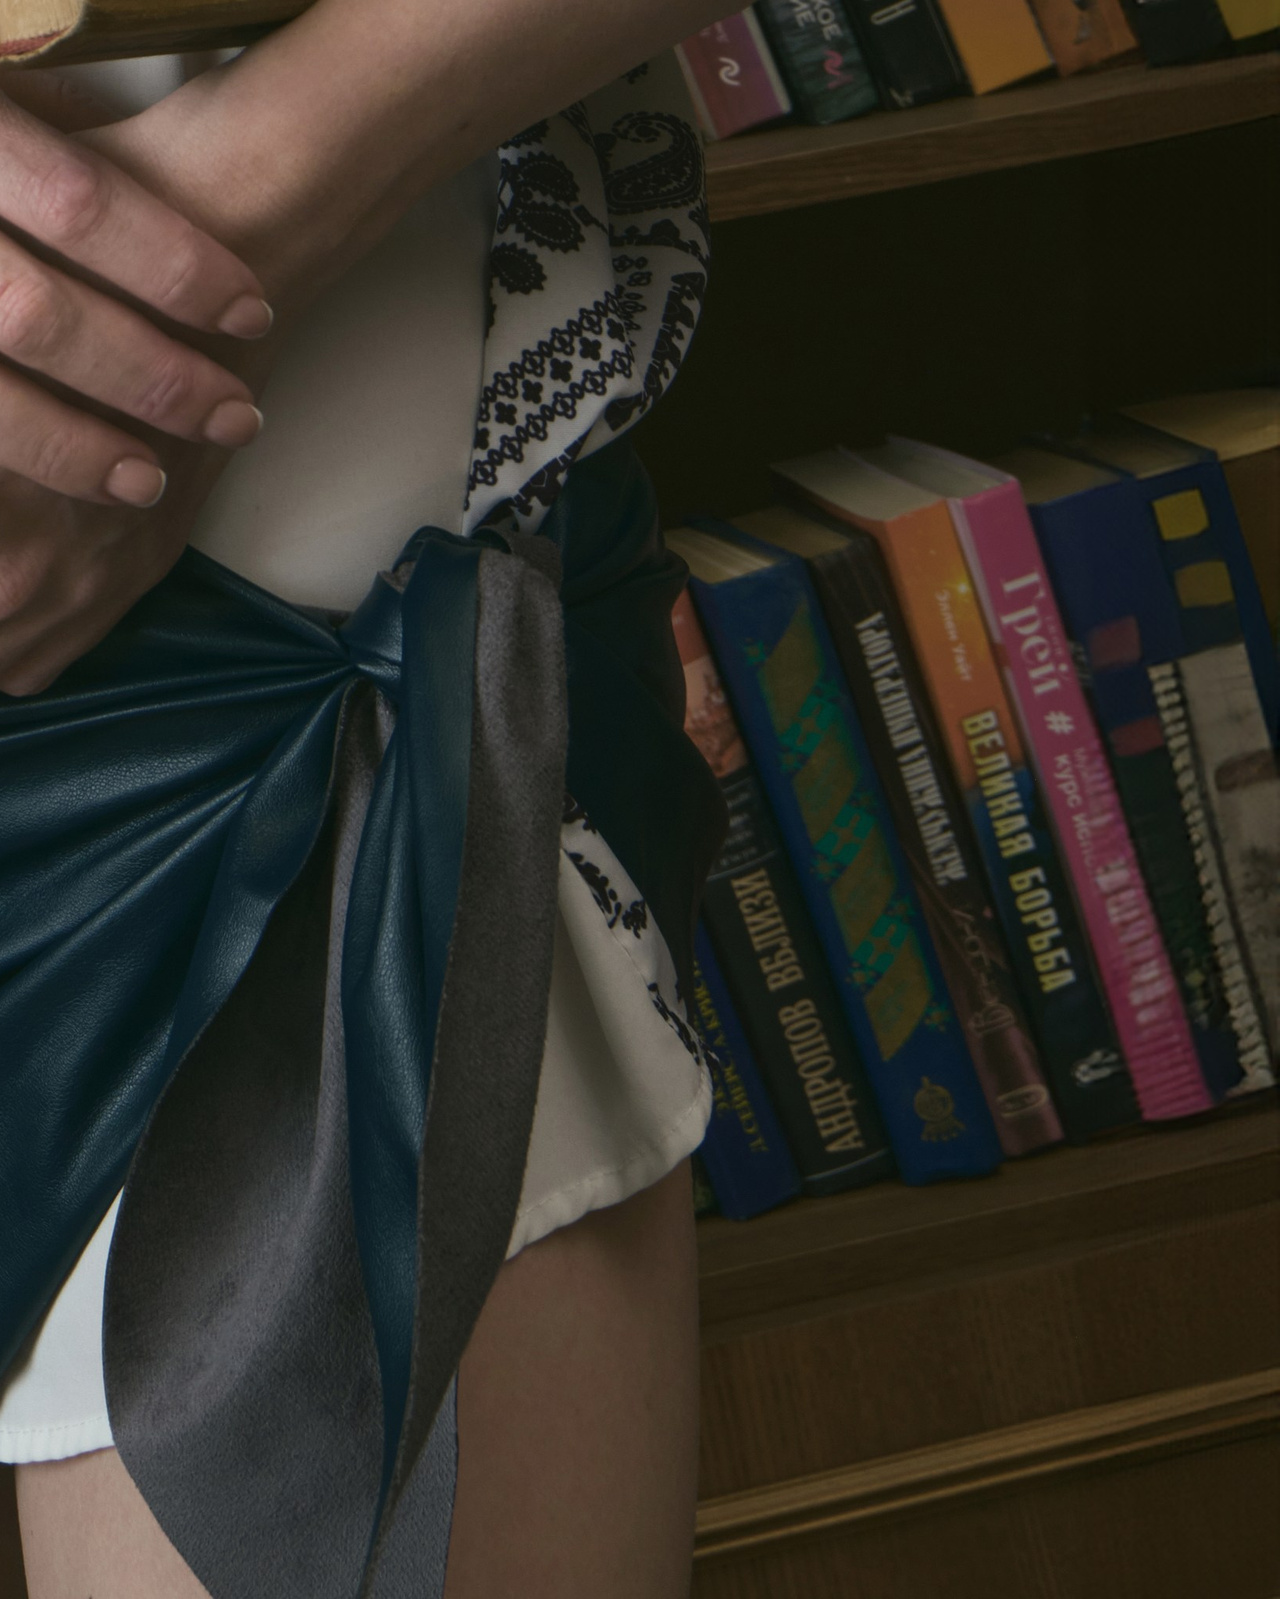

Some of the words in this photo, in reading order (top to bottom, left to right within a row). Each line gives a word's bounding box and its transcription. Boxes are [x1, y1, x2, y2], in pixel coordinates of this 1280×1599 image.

[854, 610, 925, 751] ИМПЕРАТОРА
[936, 589, 960, 642] Эллен
[954, 644, 973, 682] Уайт
[1000, 571, 1071, 697] Грей
[1054, 753, 1083, 810] курс
[896, 739, 970, 886] ЖЕМЧУЖИНА
[961, 710, 1037, 860] ВЕЛИКАЯ
[1007, 866, 1077, 995] БОРЬБА
[730, 867, 806, 994] ВБЛИЗИ
[777, 996, 866, 1155] АНДРОПОВ
